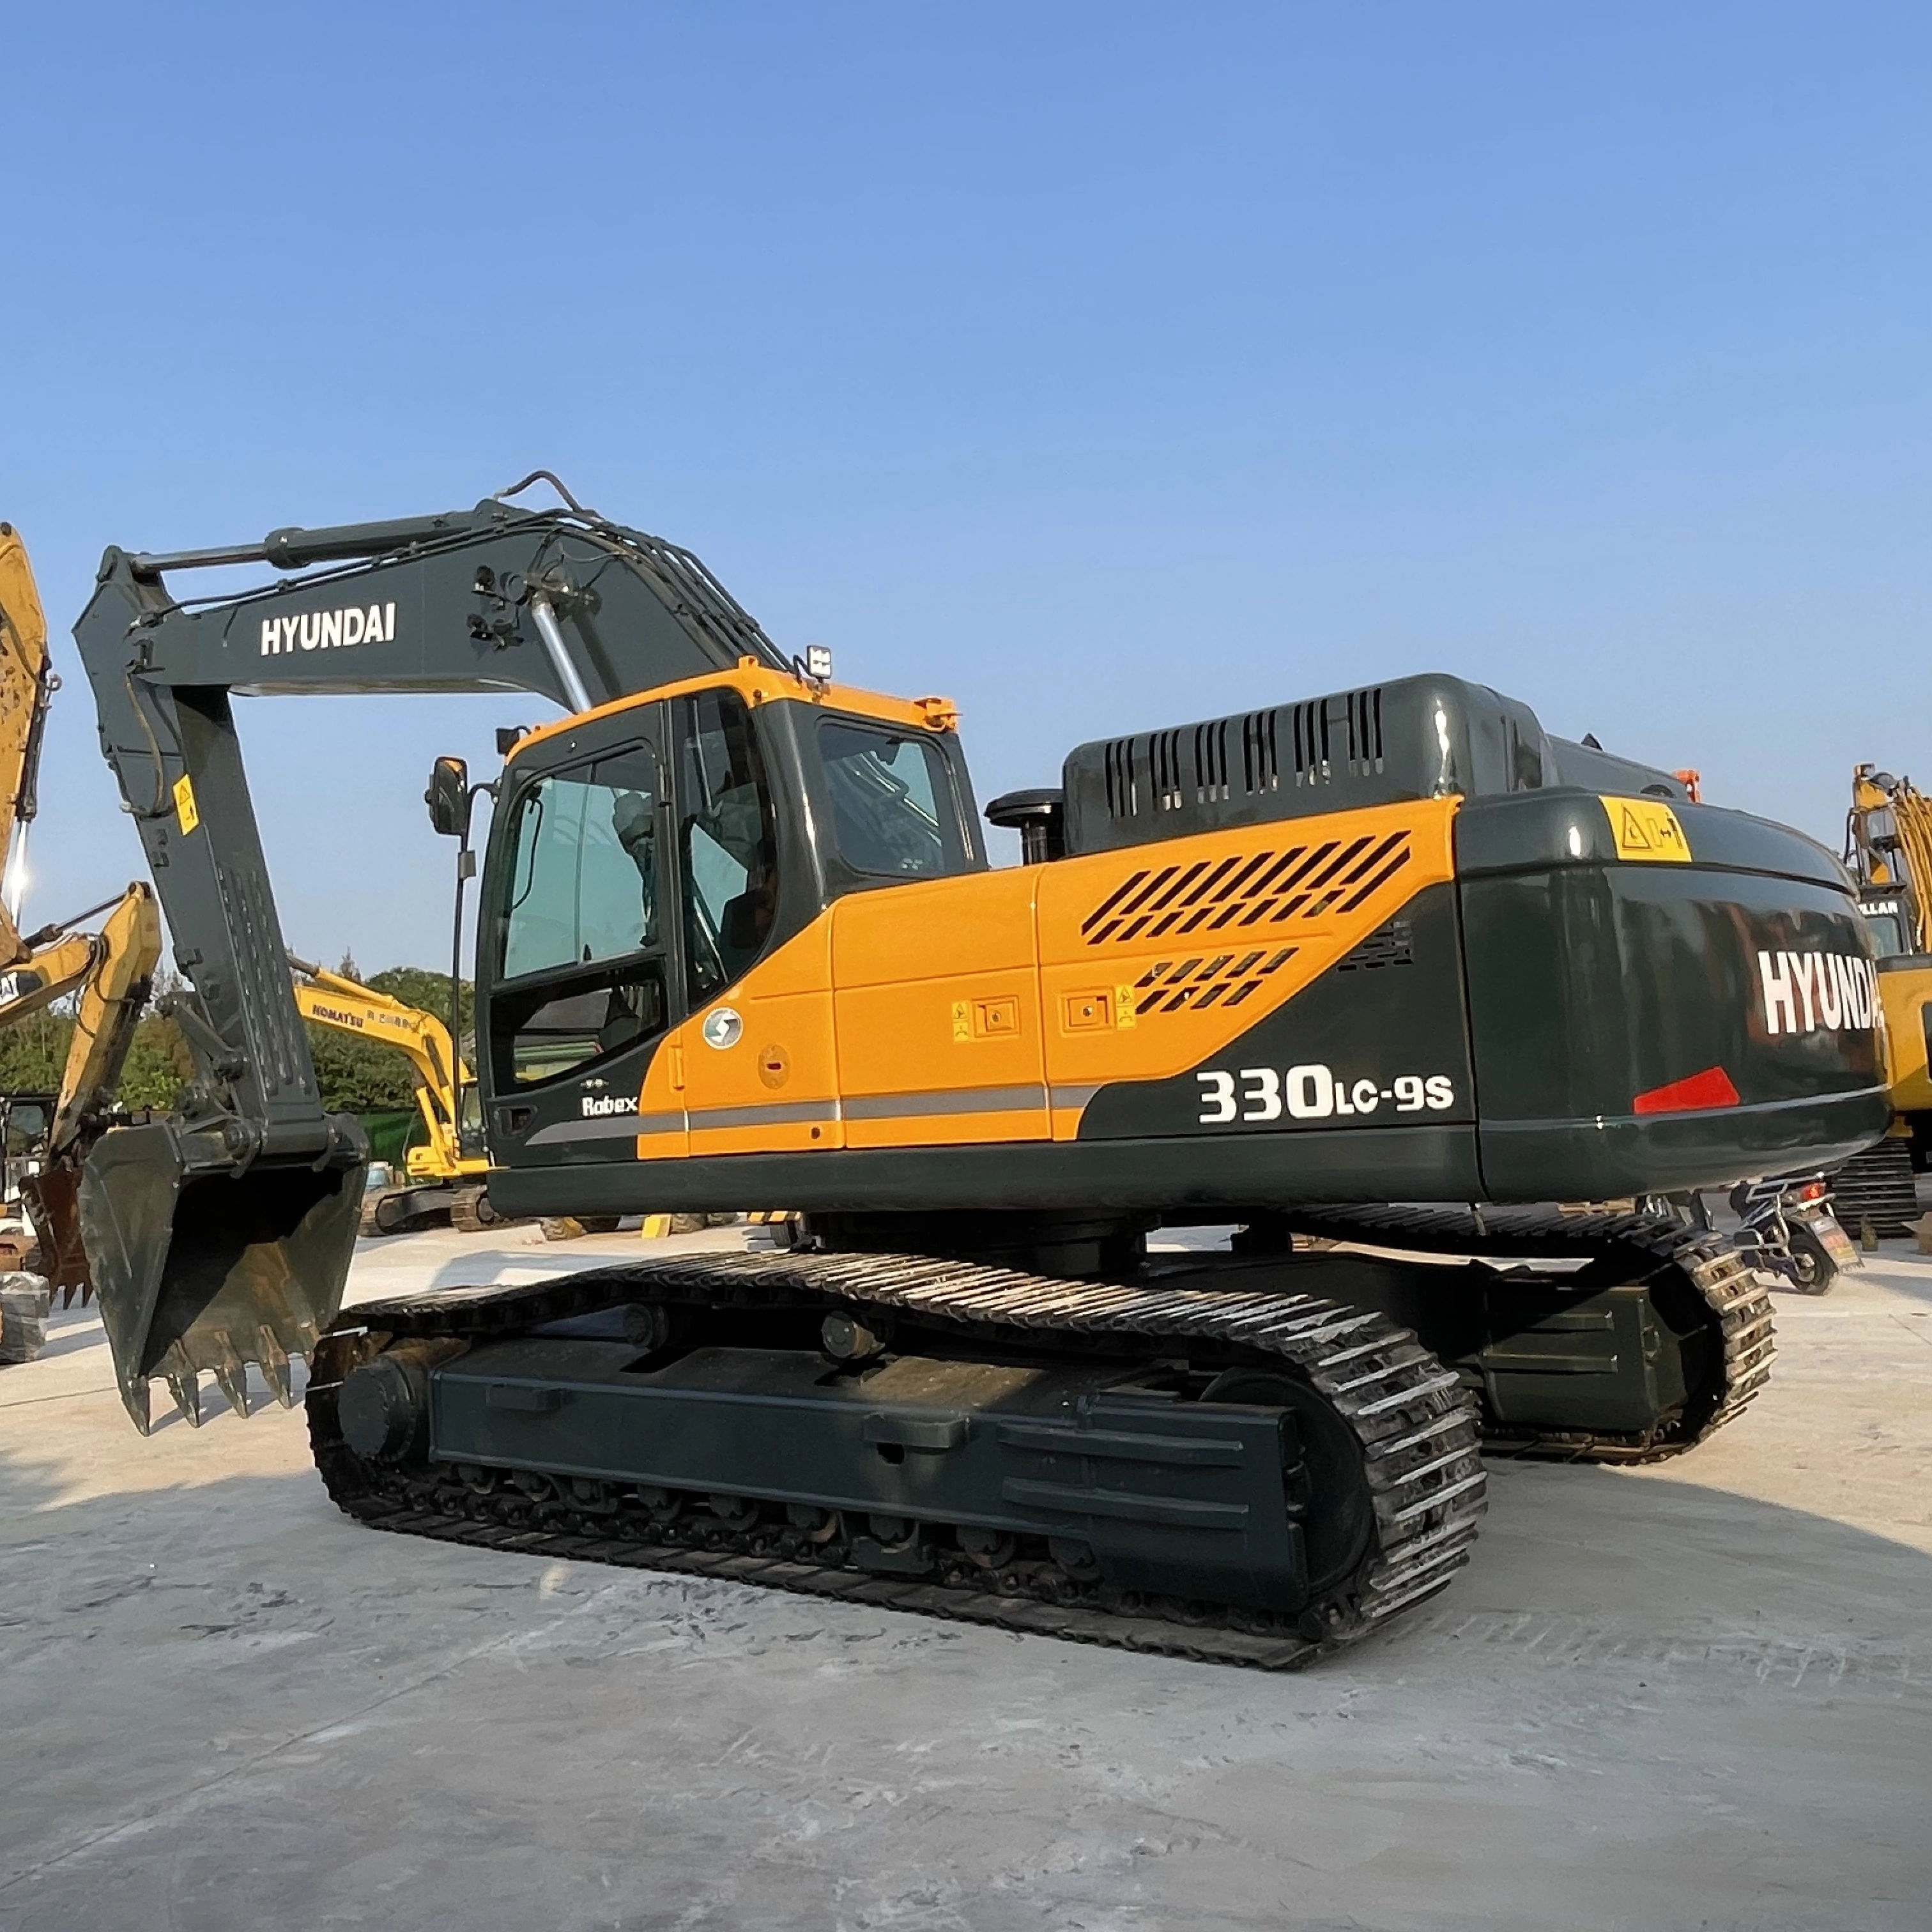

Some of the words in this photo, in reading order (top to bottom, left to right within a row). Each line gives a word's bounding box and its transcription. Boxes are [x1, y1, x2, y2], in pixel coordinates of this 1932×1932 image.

[261, 602, 395, 656] HYUNDAI
[0, 971, 19, 997] AT
[1758, 951, 1883, 1035] HYUNDA
